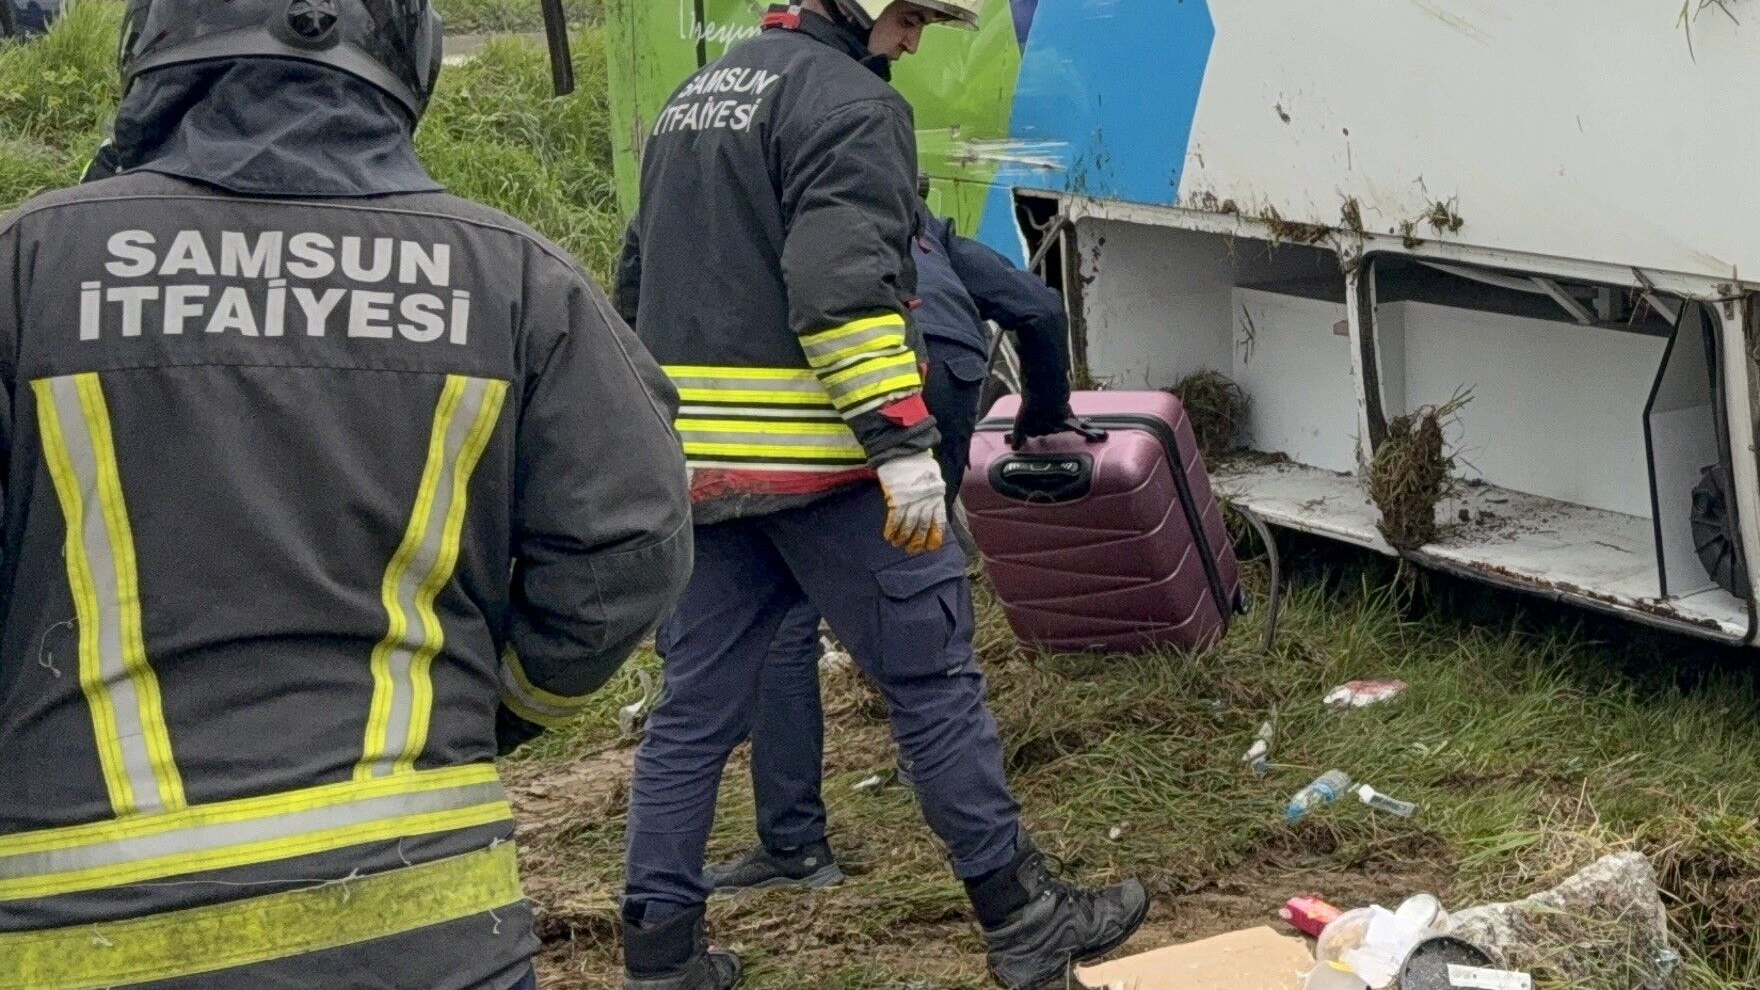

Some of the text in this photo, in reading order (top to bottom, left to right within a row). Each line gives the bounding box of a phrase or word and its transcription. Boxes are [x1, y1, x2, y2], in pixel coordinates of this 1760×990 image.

[678, 67, 780, 98] SAMSUN
[104, 229, 451, 287] SAMSUN
[79, 278, 471, 345] İTFAİYESİ
